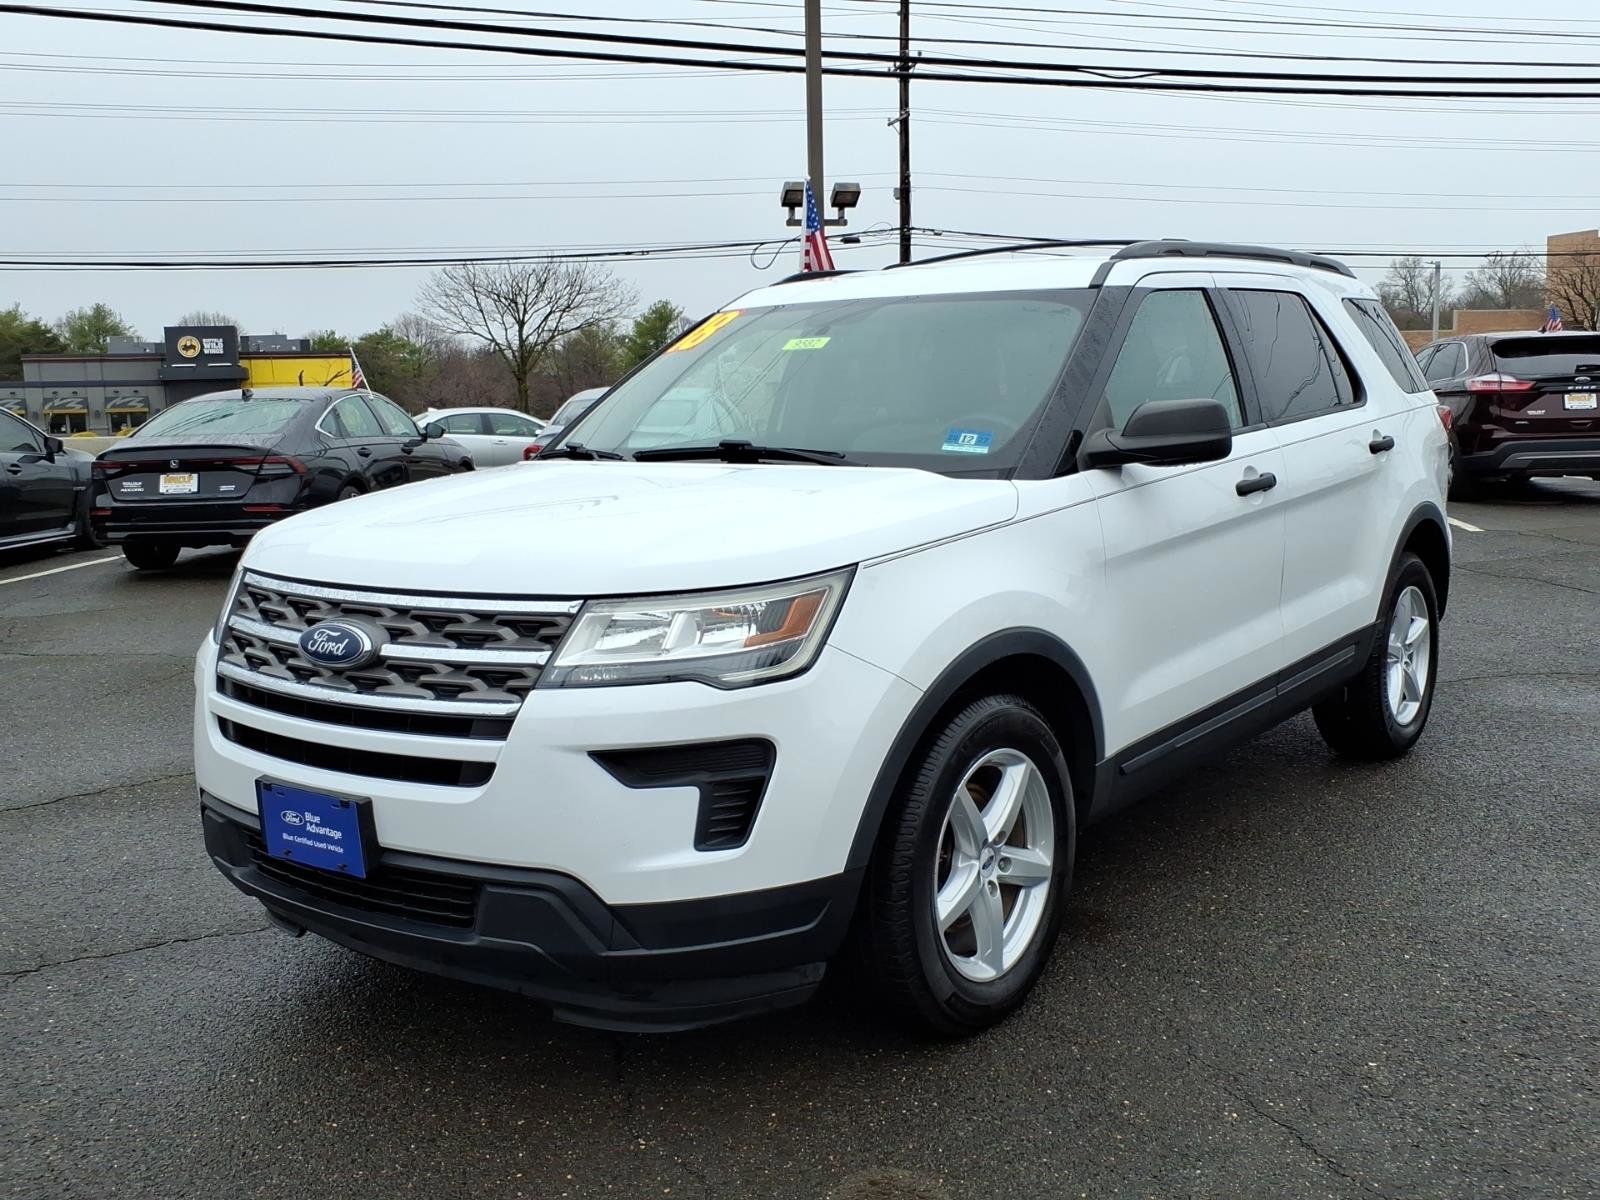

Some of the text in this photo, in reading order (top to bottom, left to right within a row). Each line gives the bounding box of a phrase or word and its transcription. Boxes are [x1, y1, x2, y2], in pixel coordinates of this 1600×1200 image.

[961, 434, 975, 444] 12
[308, 628, 349, 656] Ford
[285, 811, 321, 824] Ford Blue
[306, 823, 343, 840] Advantage
[282, 832, 344, 854] Blue Certified Used Vehicle
